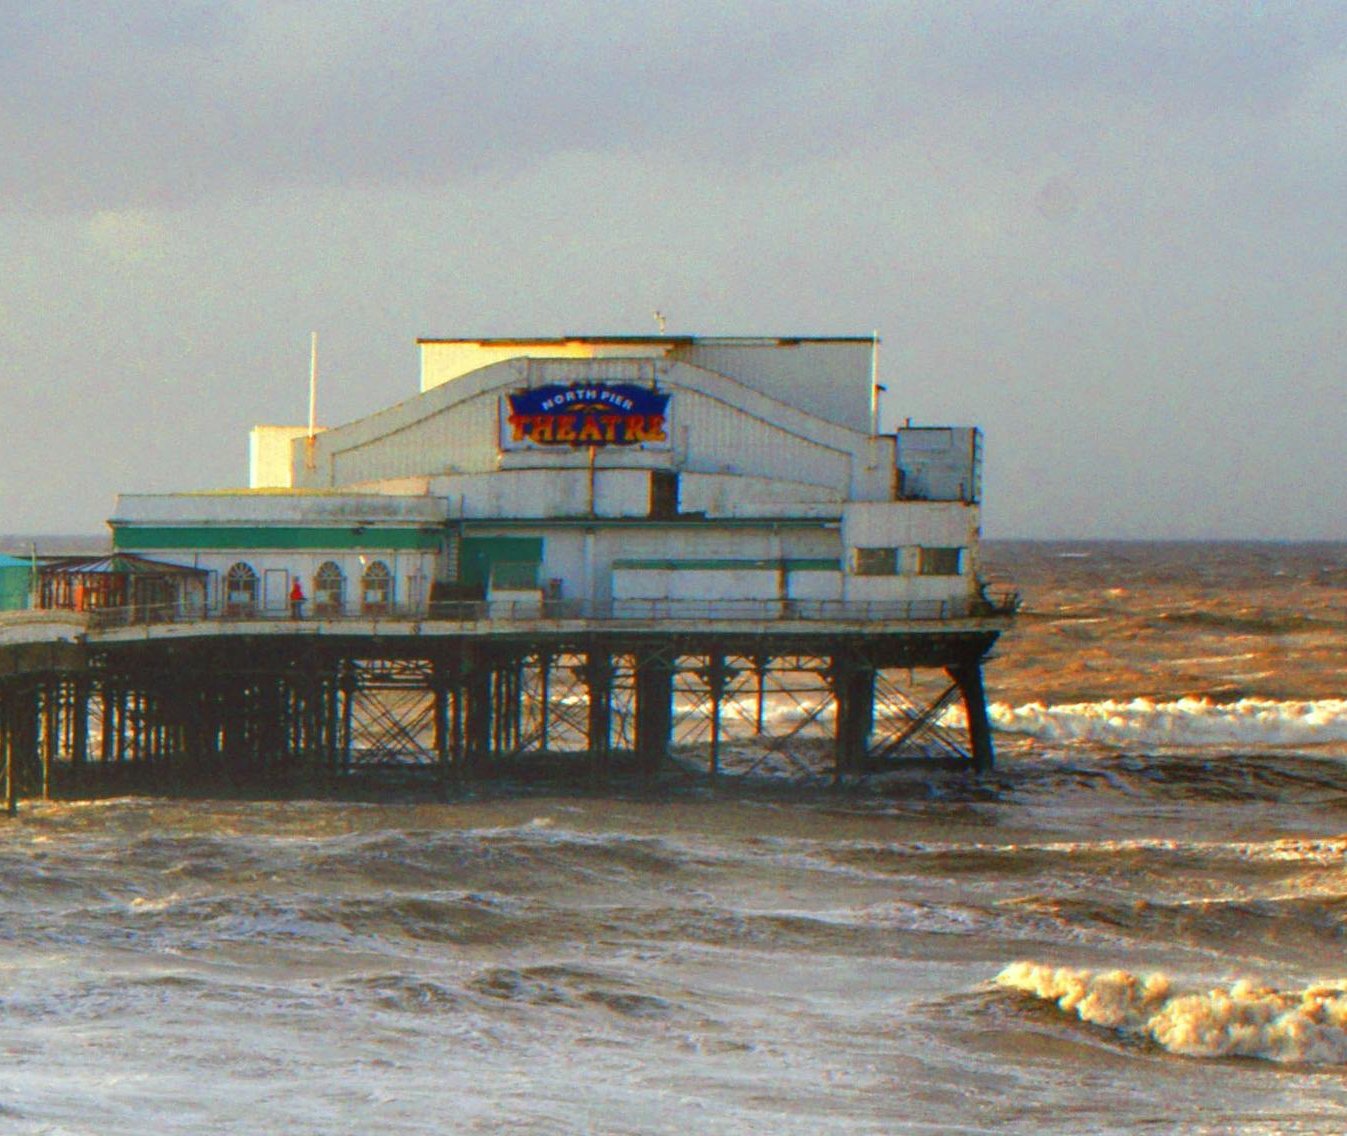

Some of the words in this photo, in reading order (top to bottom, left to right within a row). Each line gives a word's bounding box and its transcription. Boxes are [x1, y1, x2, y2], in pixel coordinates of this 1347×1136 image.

[542, 389, 597, 411] NORTH
[600, 390, 633, 411] PIER
[508, 414, 667, 442] THEATRE
